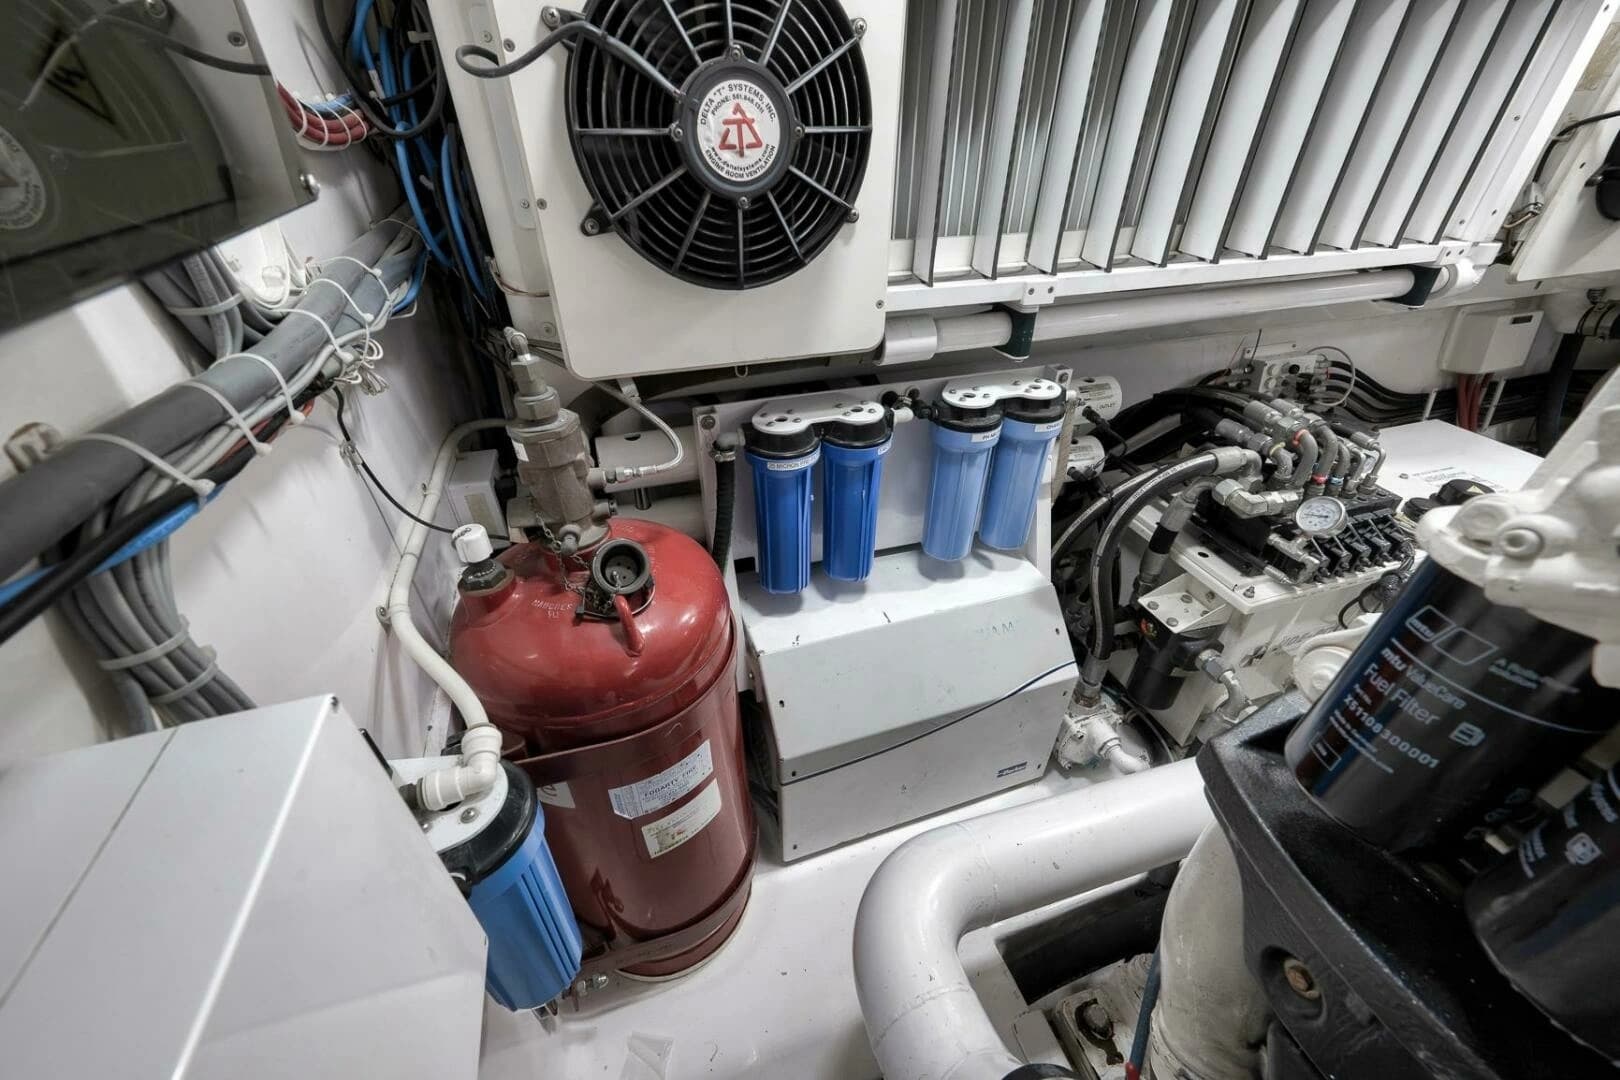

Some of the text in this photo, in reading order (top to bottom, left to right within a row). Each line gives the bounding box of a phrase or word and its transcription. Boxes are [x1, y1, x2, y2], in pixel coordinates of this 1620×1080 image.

[700, 98, 715, 125] DELTA
[711, 95, 732, 116] PHONE:
[705, 145, 776, 178] ENGINE ROOM VENTILATION
[1364, 662, 1396, 697] Fuel
[1391, 688, 1440, 725] Filter
[1381, 647, 1407, 671] mtu
[1406, 664, 1467, 710] ValueCare
